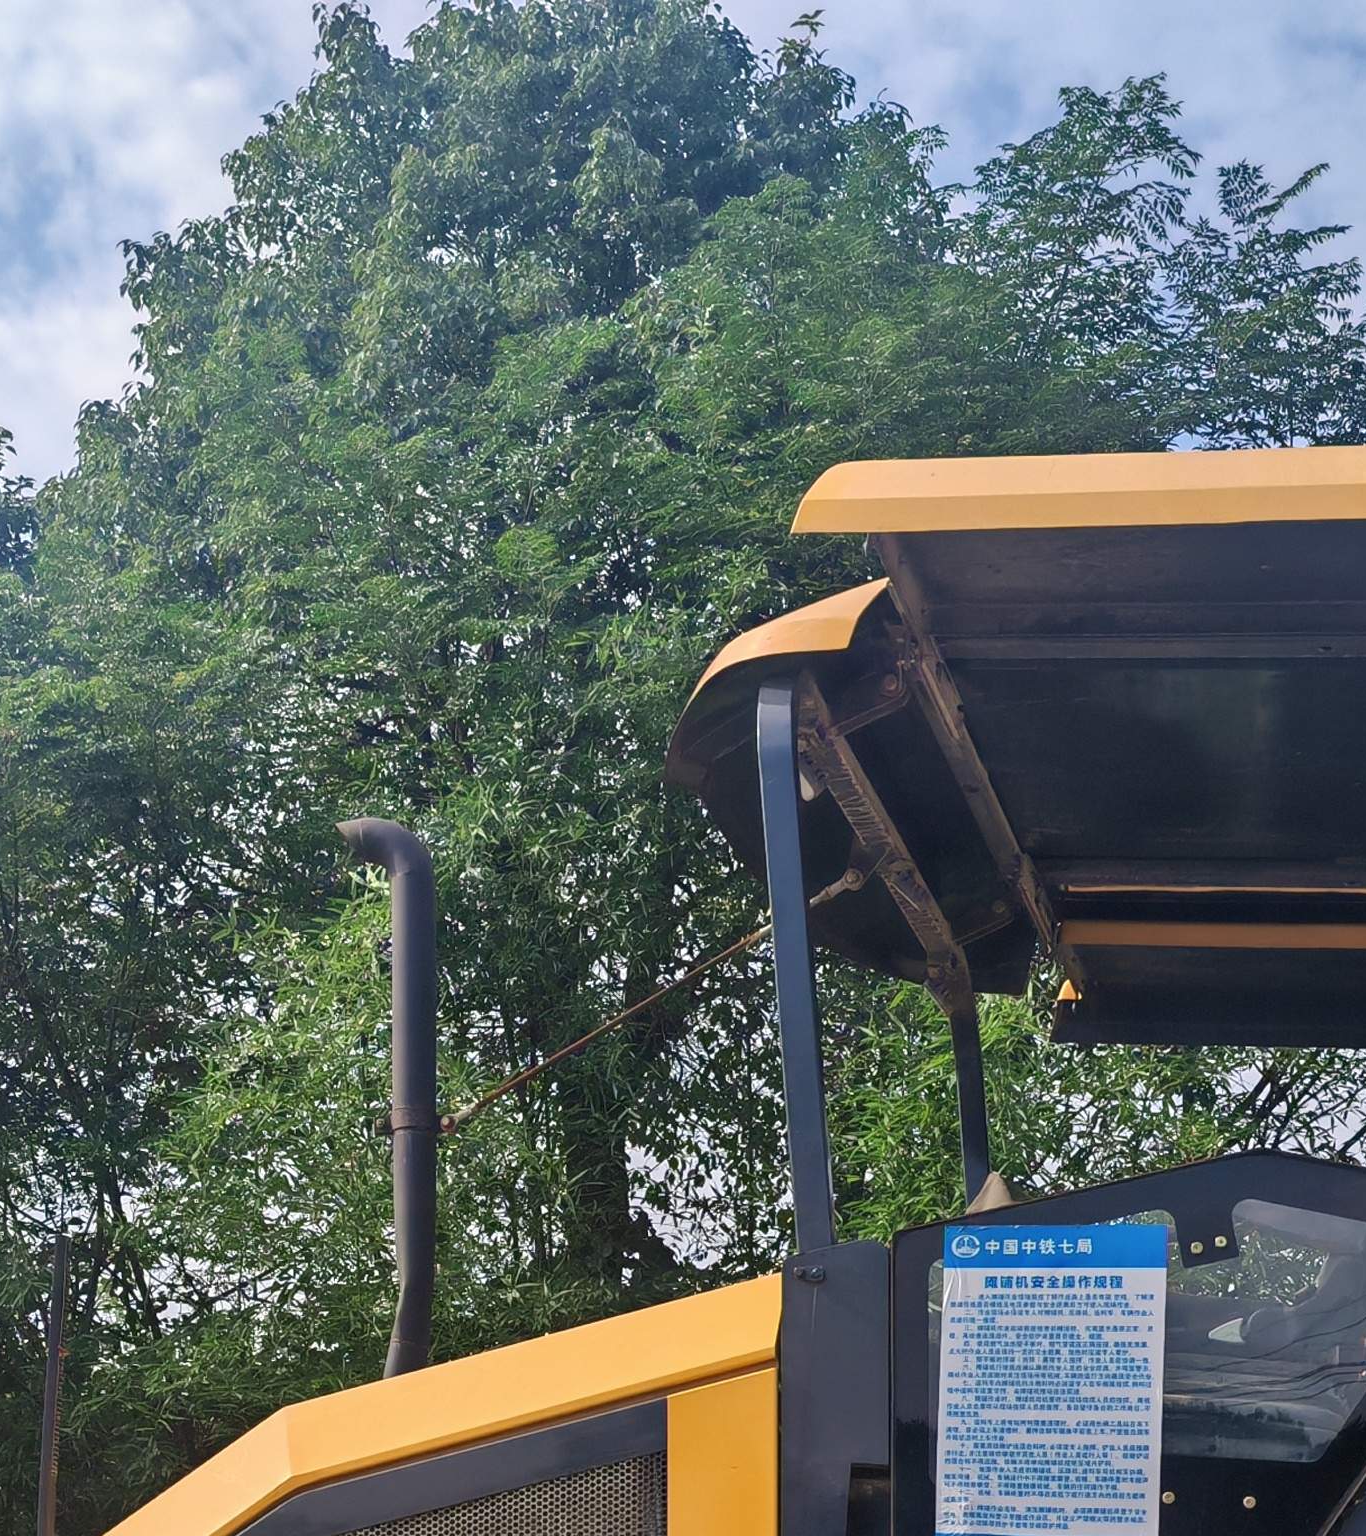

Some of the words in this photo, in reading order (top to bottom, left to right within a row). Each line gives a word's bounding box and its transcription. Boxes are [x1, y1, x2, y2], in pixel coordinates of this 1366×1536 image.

[985, 1238, 1092, 1255] 中国中铁七局
